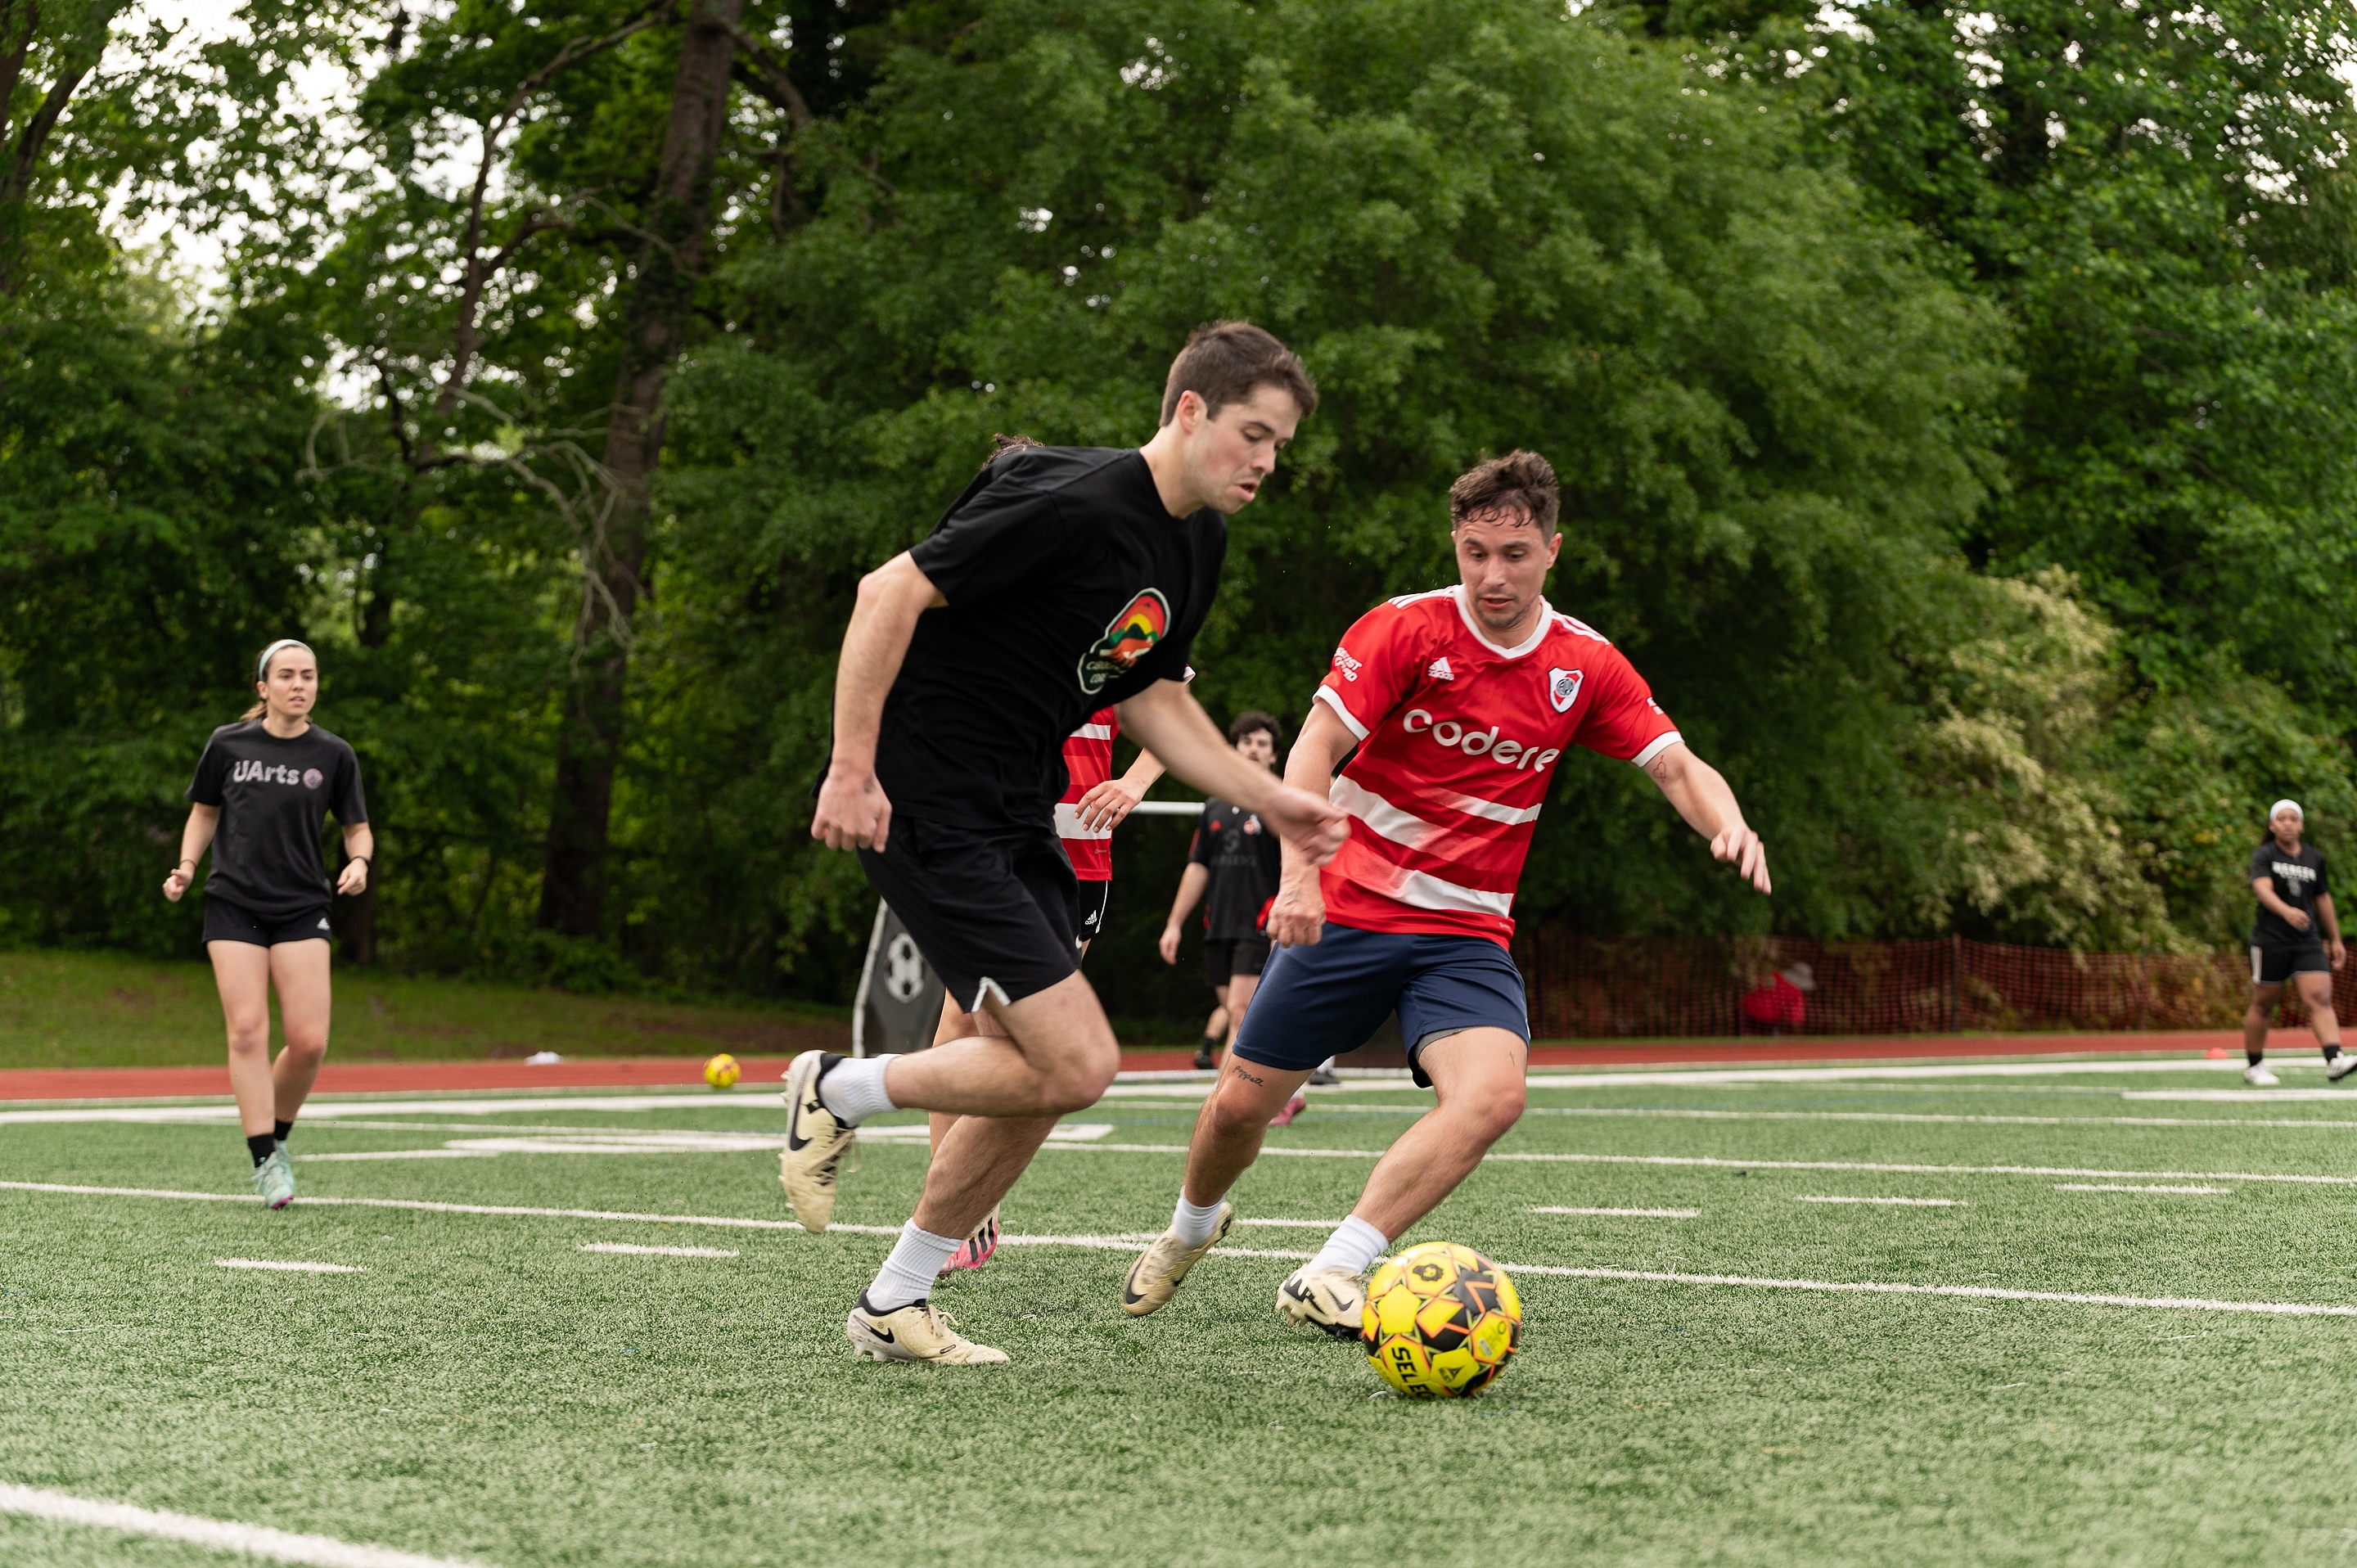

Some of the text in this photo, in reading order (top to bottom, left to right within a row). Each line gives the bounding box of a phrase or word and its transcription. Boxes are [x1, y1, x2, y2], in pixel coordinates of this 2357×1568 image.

[1403, 709, 1560, 773] codere
[233, 759, 300, 786] UArts
[1390, 1346, 1435, 1399] SELEC
